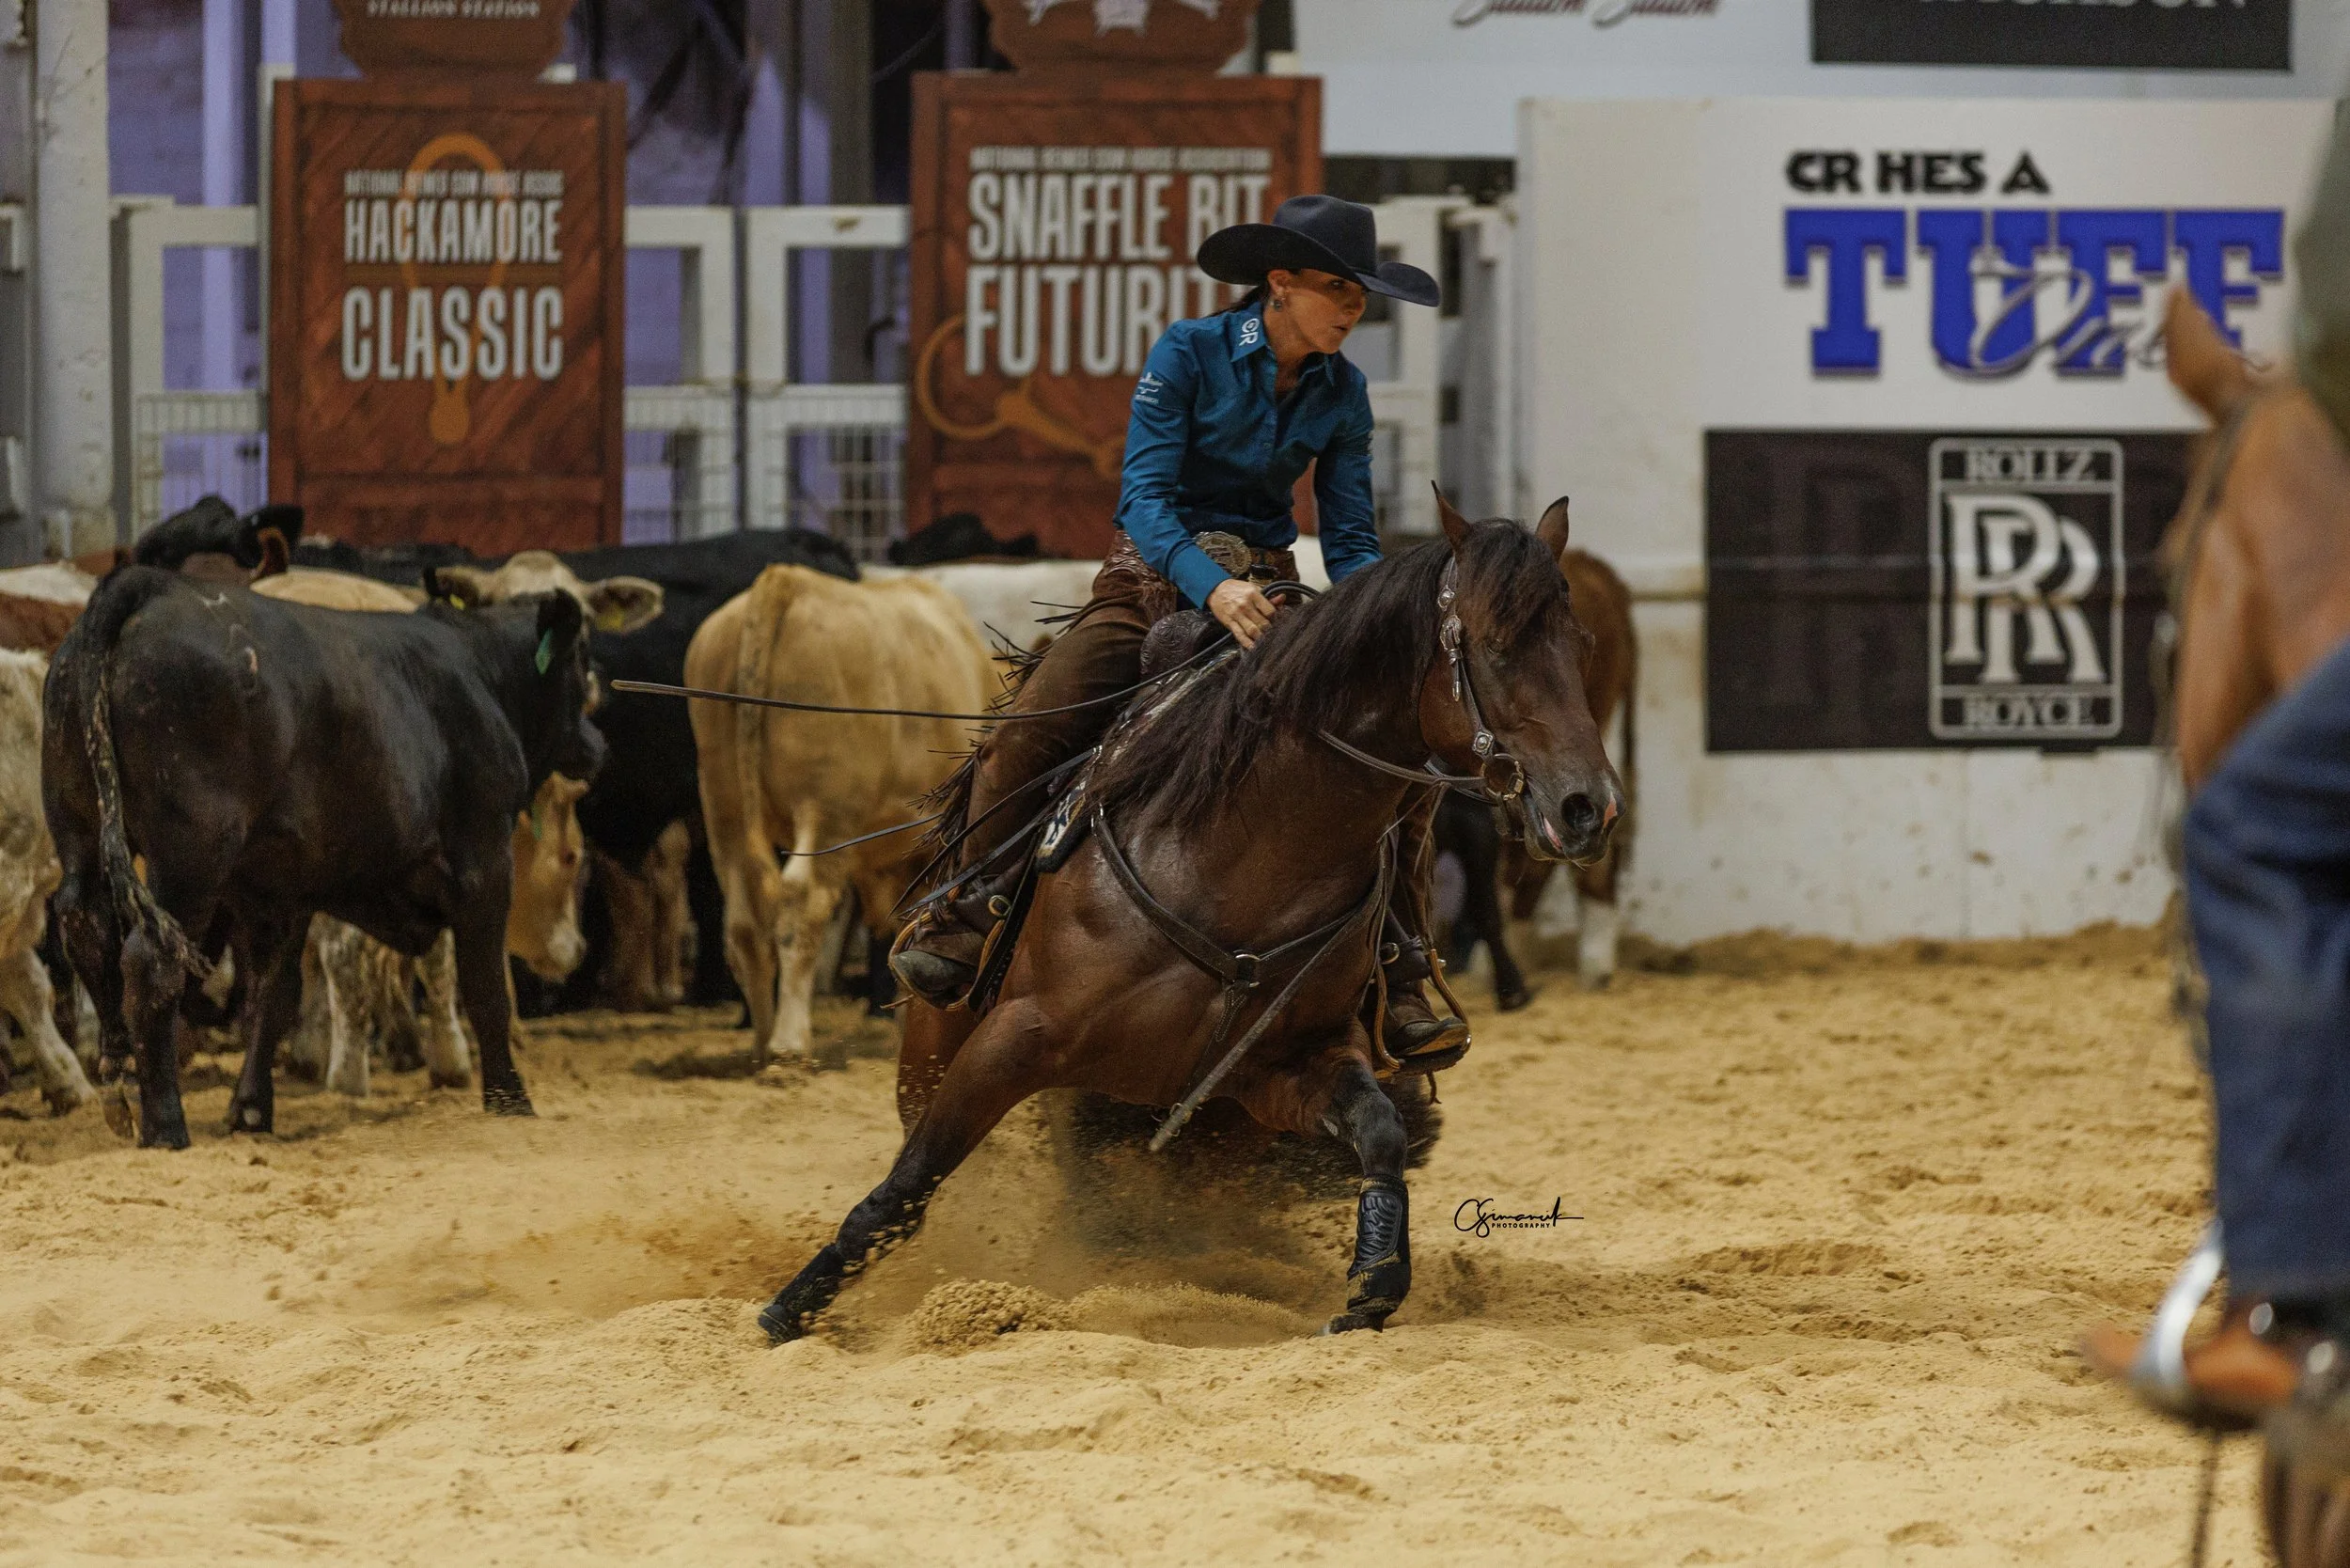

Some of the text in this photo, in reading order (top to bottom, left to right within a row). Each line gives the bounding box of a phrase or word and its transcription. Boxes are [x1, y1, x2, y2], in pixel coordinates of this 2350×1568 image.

[1784, 150, 1862, 194] CR
[344, 199, 562, 263] HACKAMORE
[968, 173, 1173, 260] SNAFFLE
[342, 287, 564, 380] CLASSIC
[1784, 208, 2285, 378] TUFF
